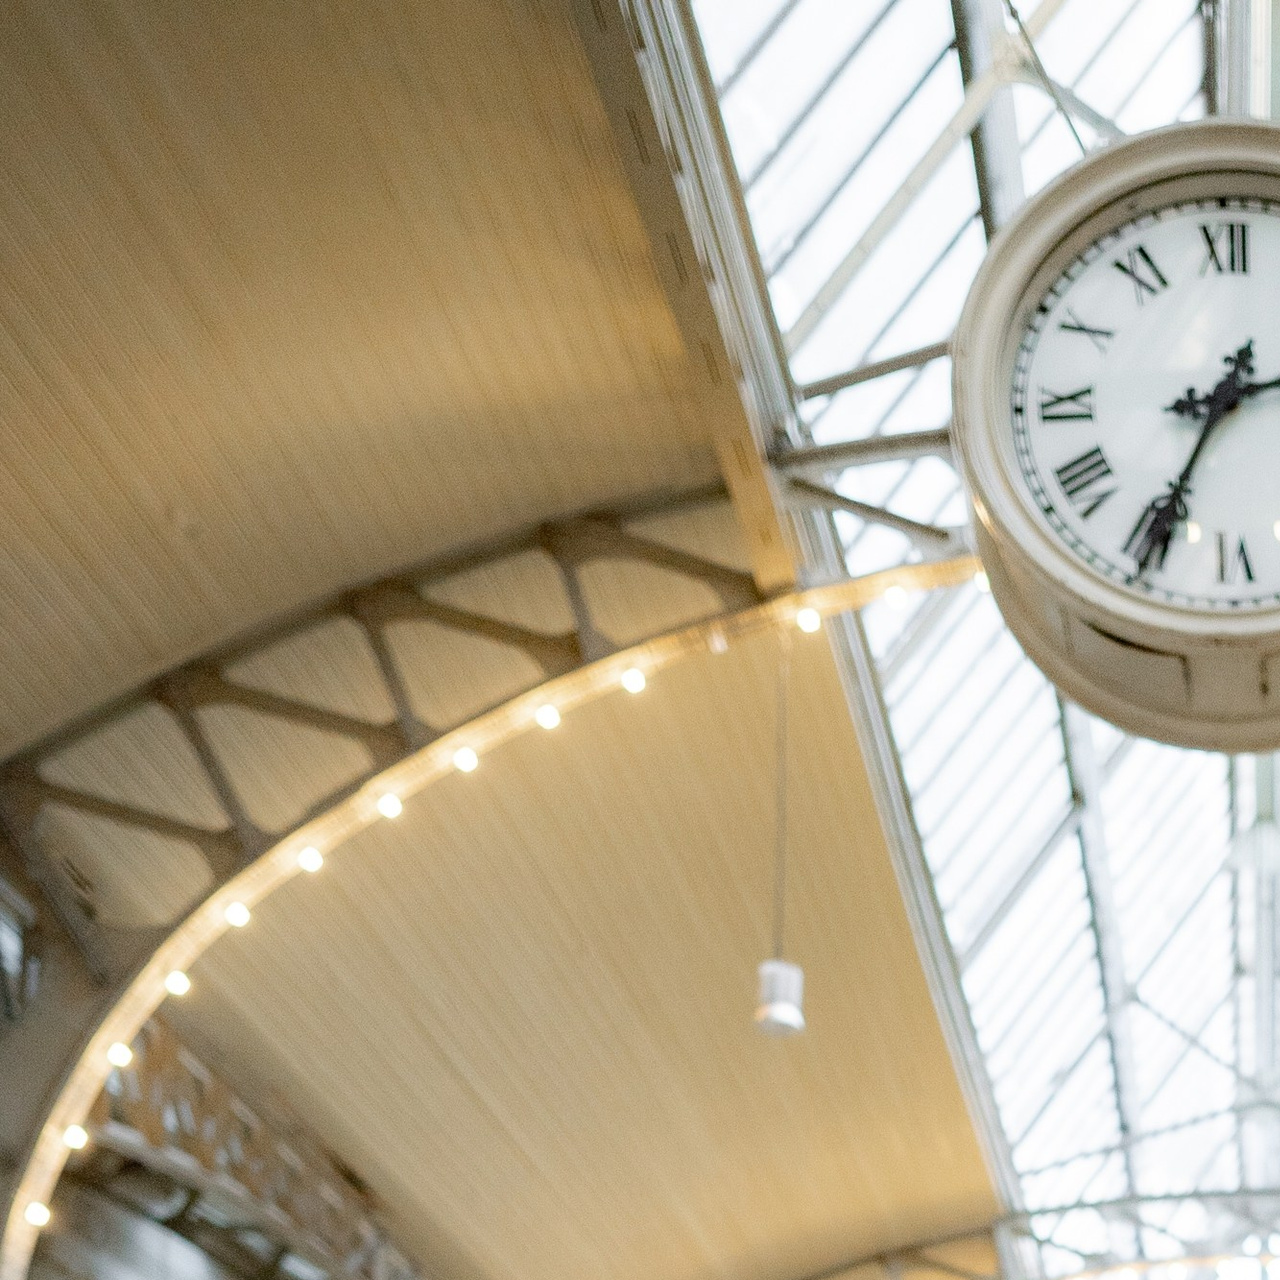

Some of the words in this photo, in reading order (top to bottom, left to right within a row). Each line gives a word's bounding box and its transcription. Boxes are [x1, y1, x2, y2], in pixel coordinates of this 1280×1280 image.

[1201, 222, 1247, 274] XII
[1114, 245, 1168, 305] XI
[1060, 307, 1114, 352] X
[1039, 384, 1093, 421] IX
[1056, 446, 1118, 519] VIII
[1215, 530, 1256, 583] VI
